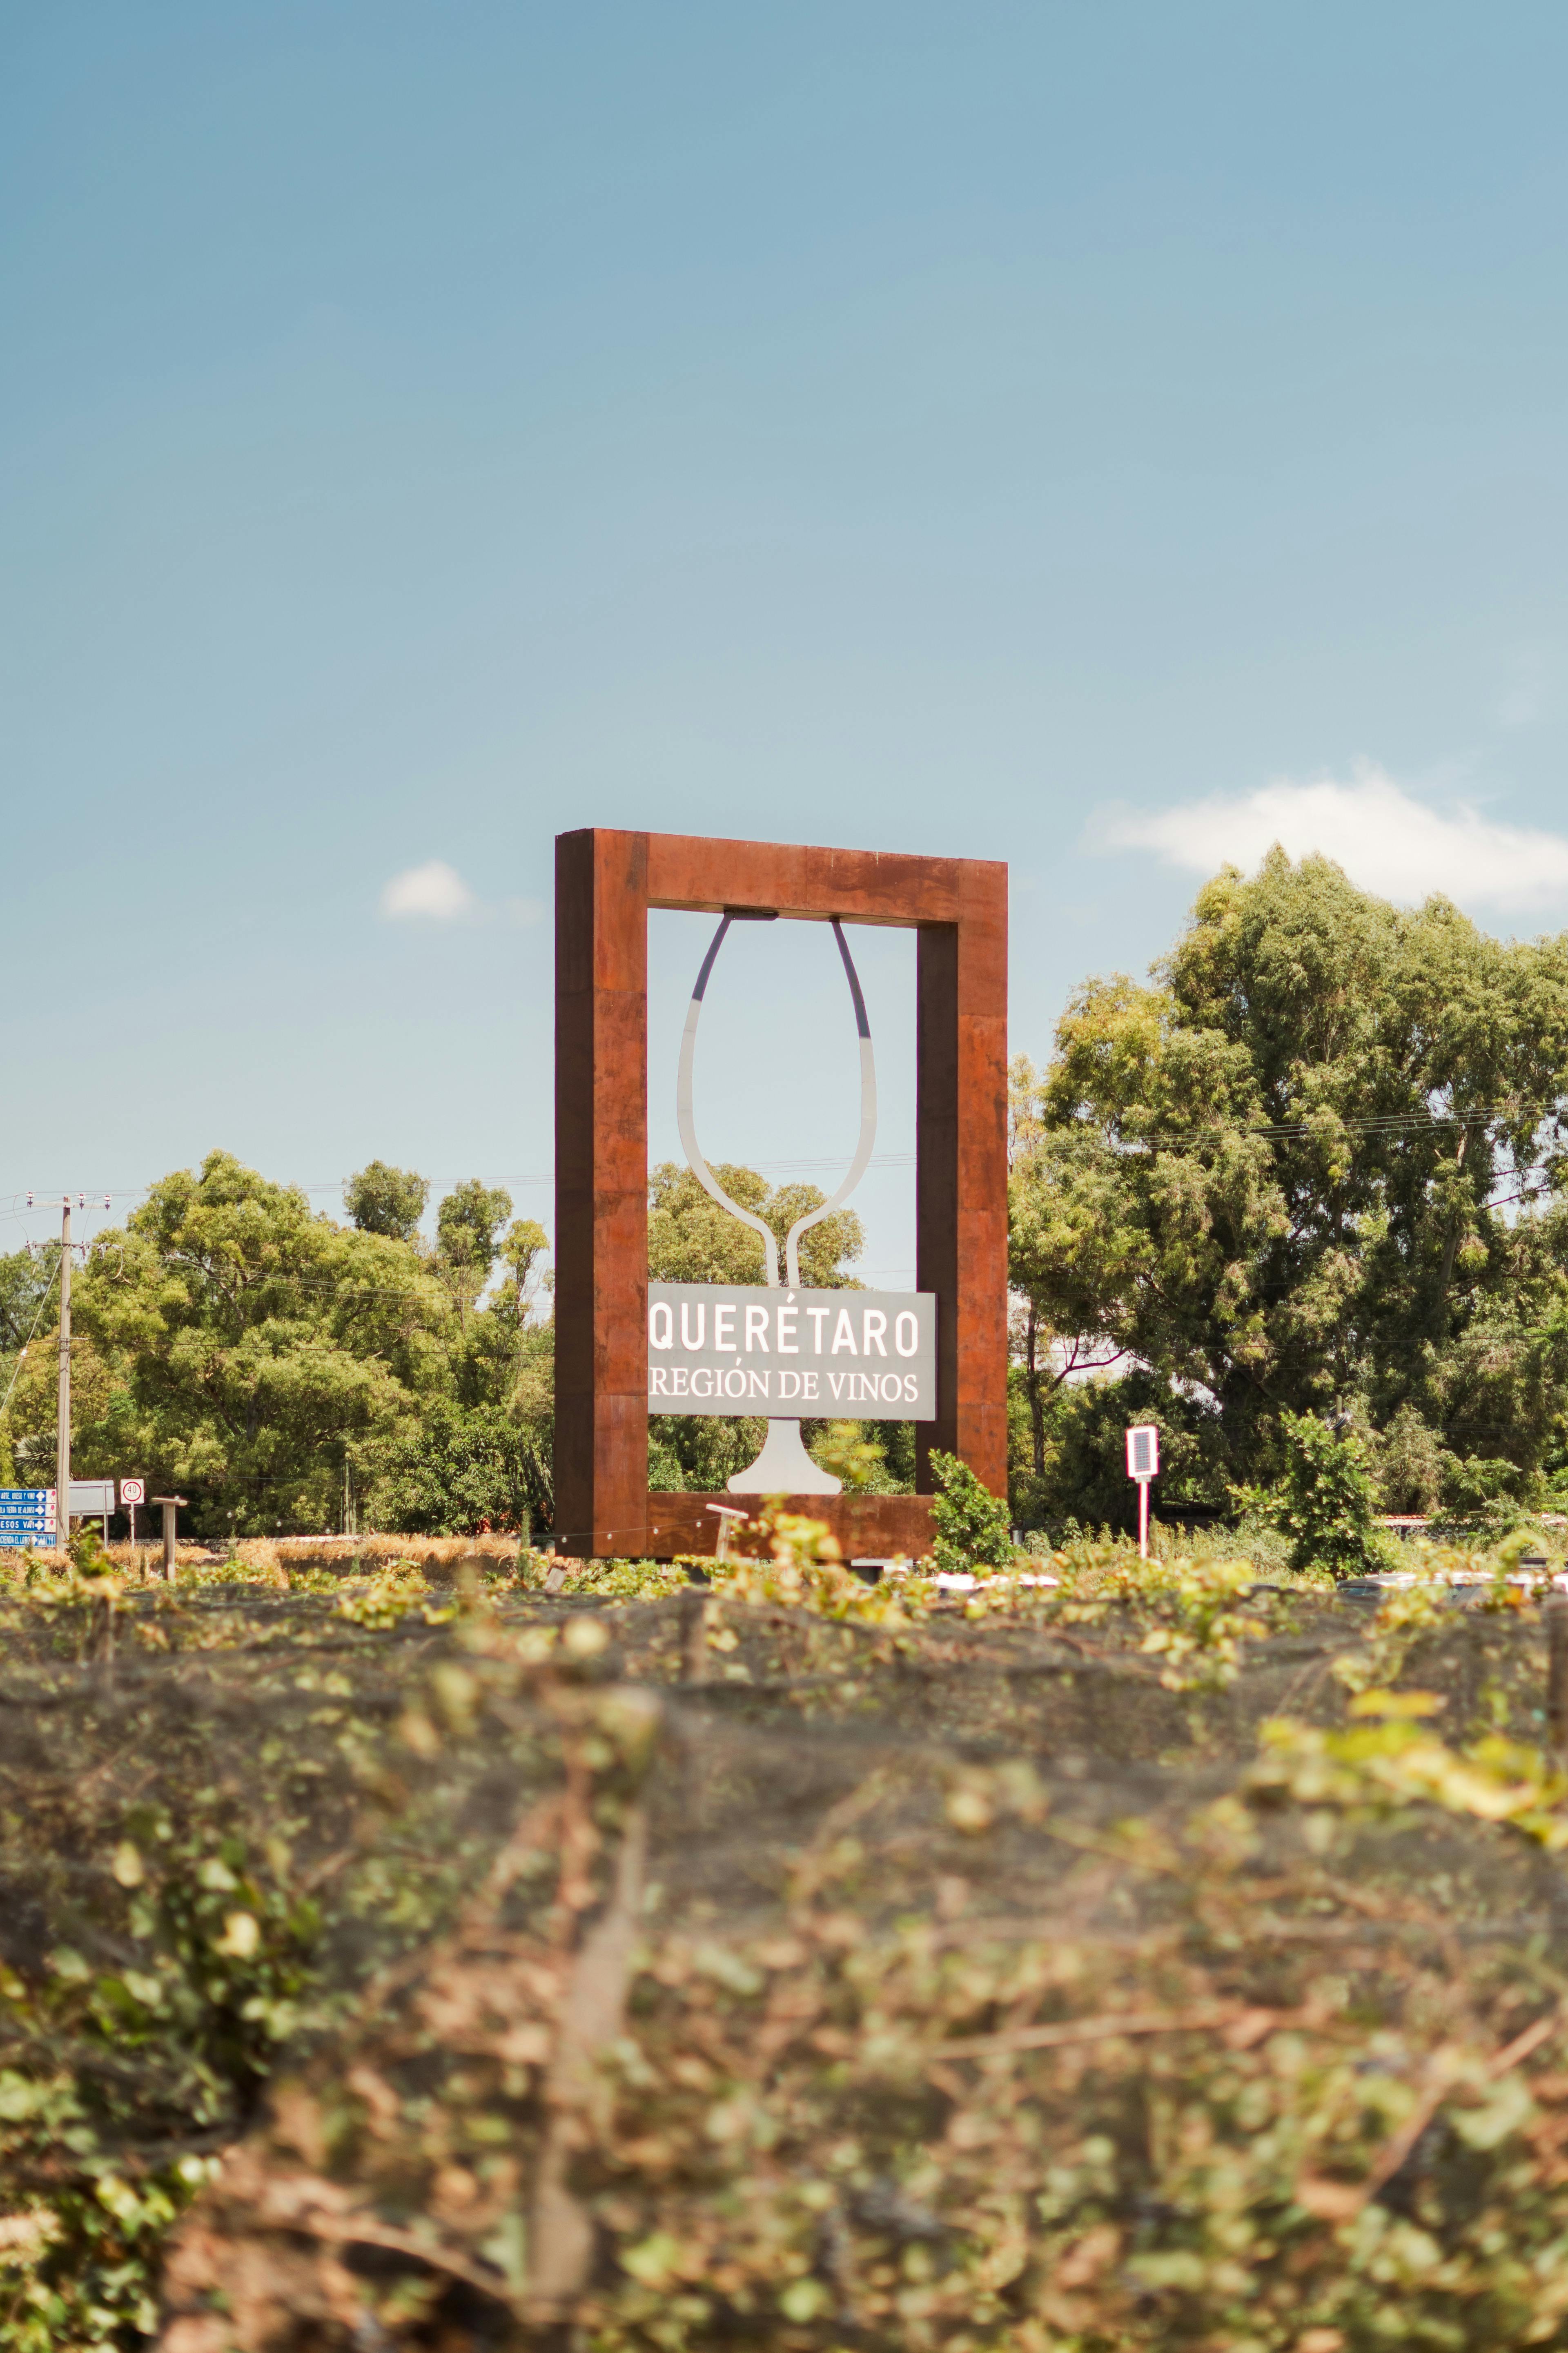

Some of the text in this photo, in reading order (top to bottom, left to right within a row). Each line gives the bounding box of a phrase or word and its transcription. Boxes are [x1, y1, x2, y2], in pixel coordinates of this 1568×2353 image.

[648, 1292, 918, 1357] QUERÉTARO
[649, 1357, 918, 1402] REGIÓN DE VINOS
